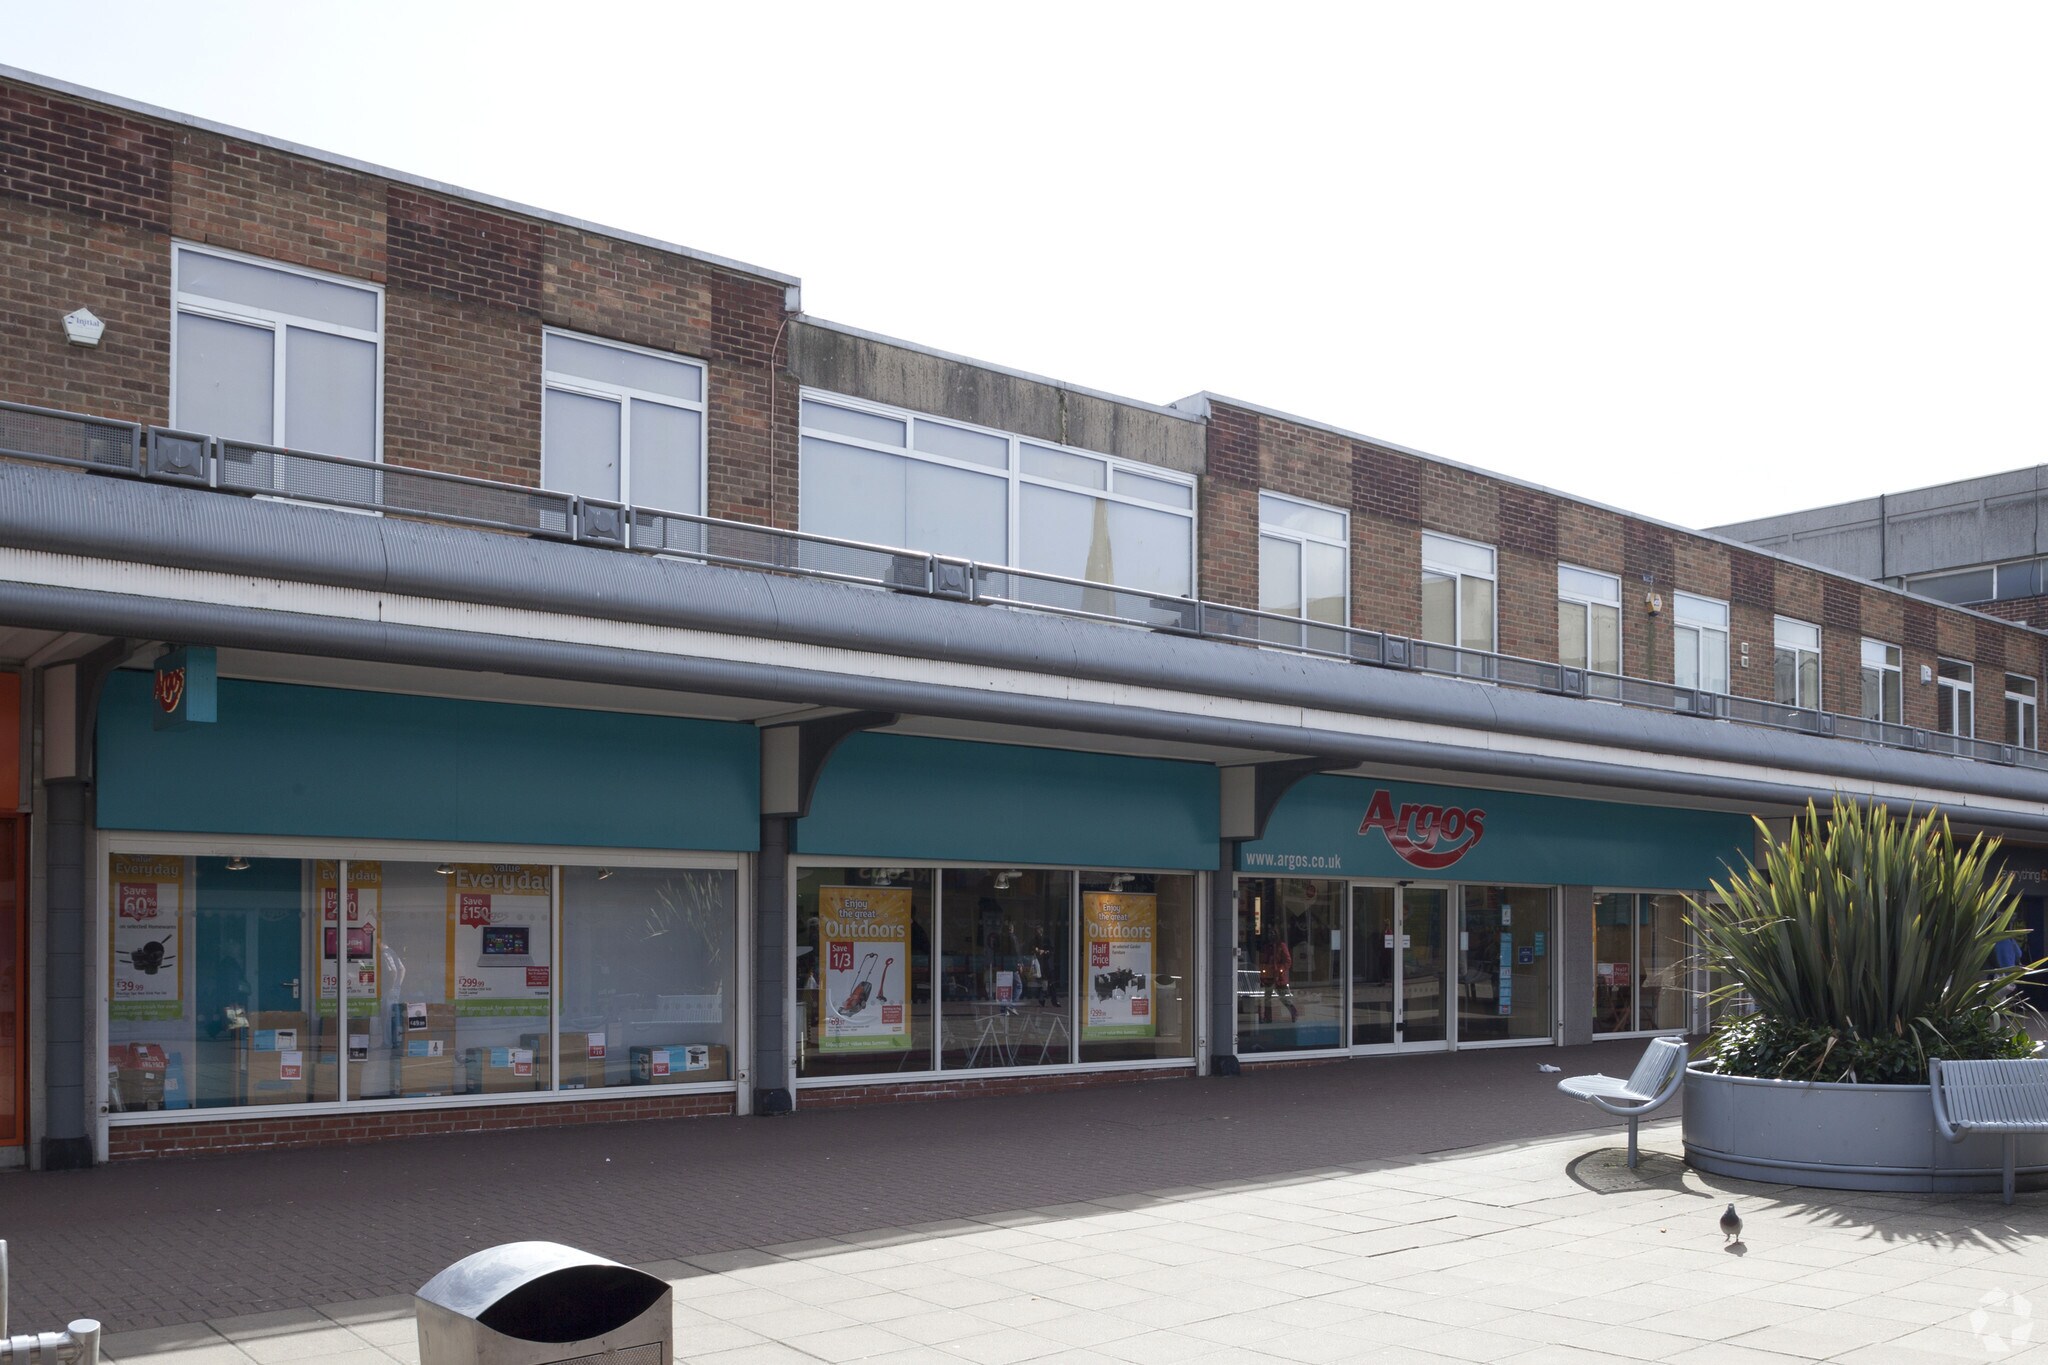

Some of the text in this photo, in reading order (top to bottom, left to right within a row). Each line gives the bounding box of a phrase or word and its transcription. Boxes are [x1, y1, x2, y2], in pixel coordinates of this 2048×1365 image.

[1357, 788, 1487, 871] Argos
[1246, 852, 1342, 870] www.argos.co.uk
[124, 886, 148, 896] Save
[124, 897, 158, 915] 60%
[463, 896, 483, 906] Save
[844, 899, 869, 912] Enjoy
[1102, 903, 1121, 913] Enjoy
[838, 909, 875, 922] the great
[1098, 913, 1128, 923] the great
[825, 919, 906, 939] Outdoors
[1088, 921, 1153, 940] Outdoors
[832, 944, 849, 953] Save
[1092, 943, 1107, 954] Half
[833, 953, 851, 969] 1/3
[1092, 954, 1109, 965] Price
[116, 980, 145, 992] £39.99
